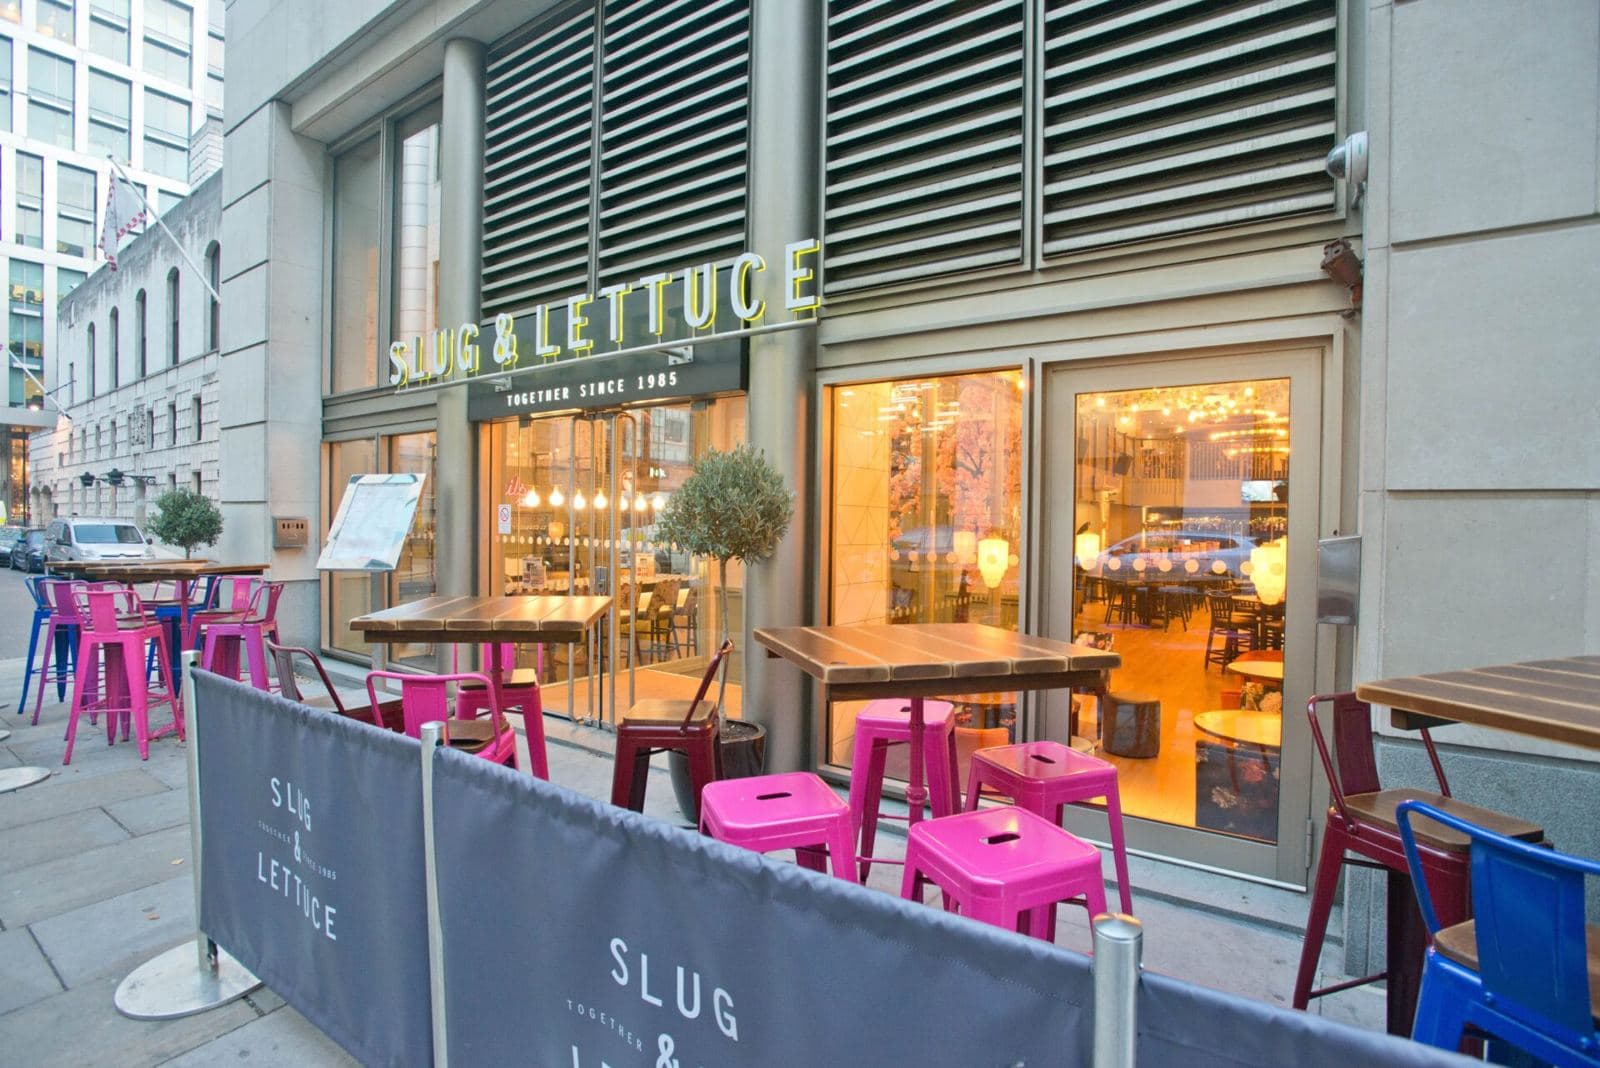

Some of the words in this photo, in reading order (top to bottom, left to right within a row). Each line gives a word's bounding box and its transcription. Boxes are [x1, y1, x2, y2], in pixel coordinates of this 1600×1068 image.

[389, 322, 480, 387] SLUG
[492, 312, 519, 366] &
[535, 238, 821, 357] LETTUCE
[506, 386, 569, 407] TOGETHER
[579, 378, 625, 398] SINCE
[637, 371, 678, 390] 1985
[270, 777, 311, 832] SLUG
[294, 830, 302, 864] &
[318, 865, 337, 880] 1985
[258, 851, 337, 941] LETTUCE
[609, 937, 739, 1042] SLUG
[567, 999, 642, 1052] TOGETHER
